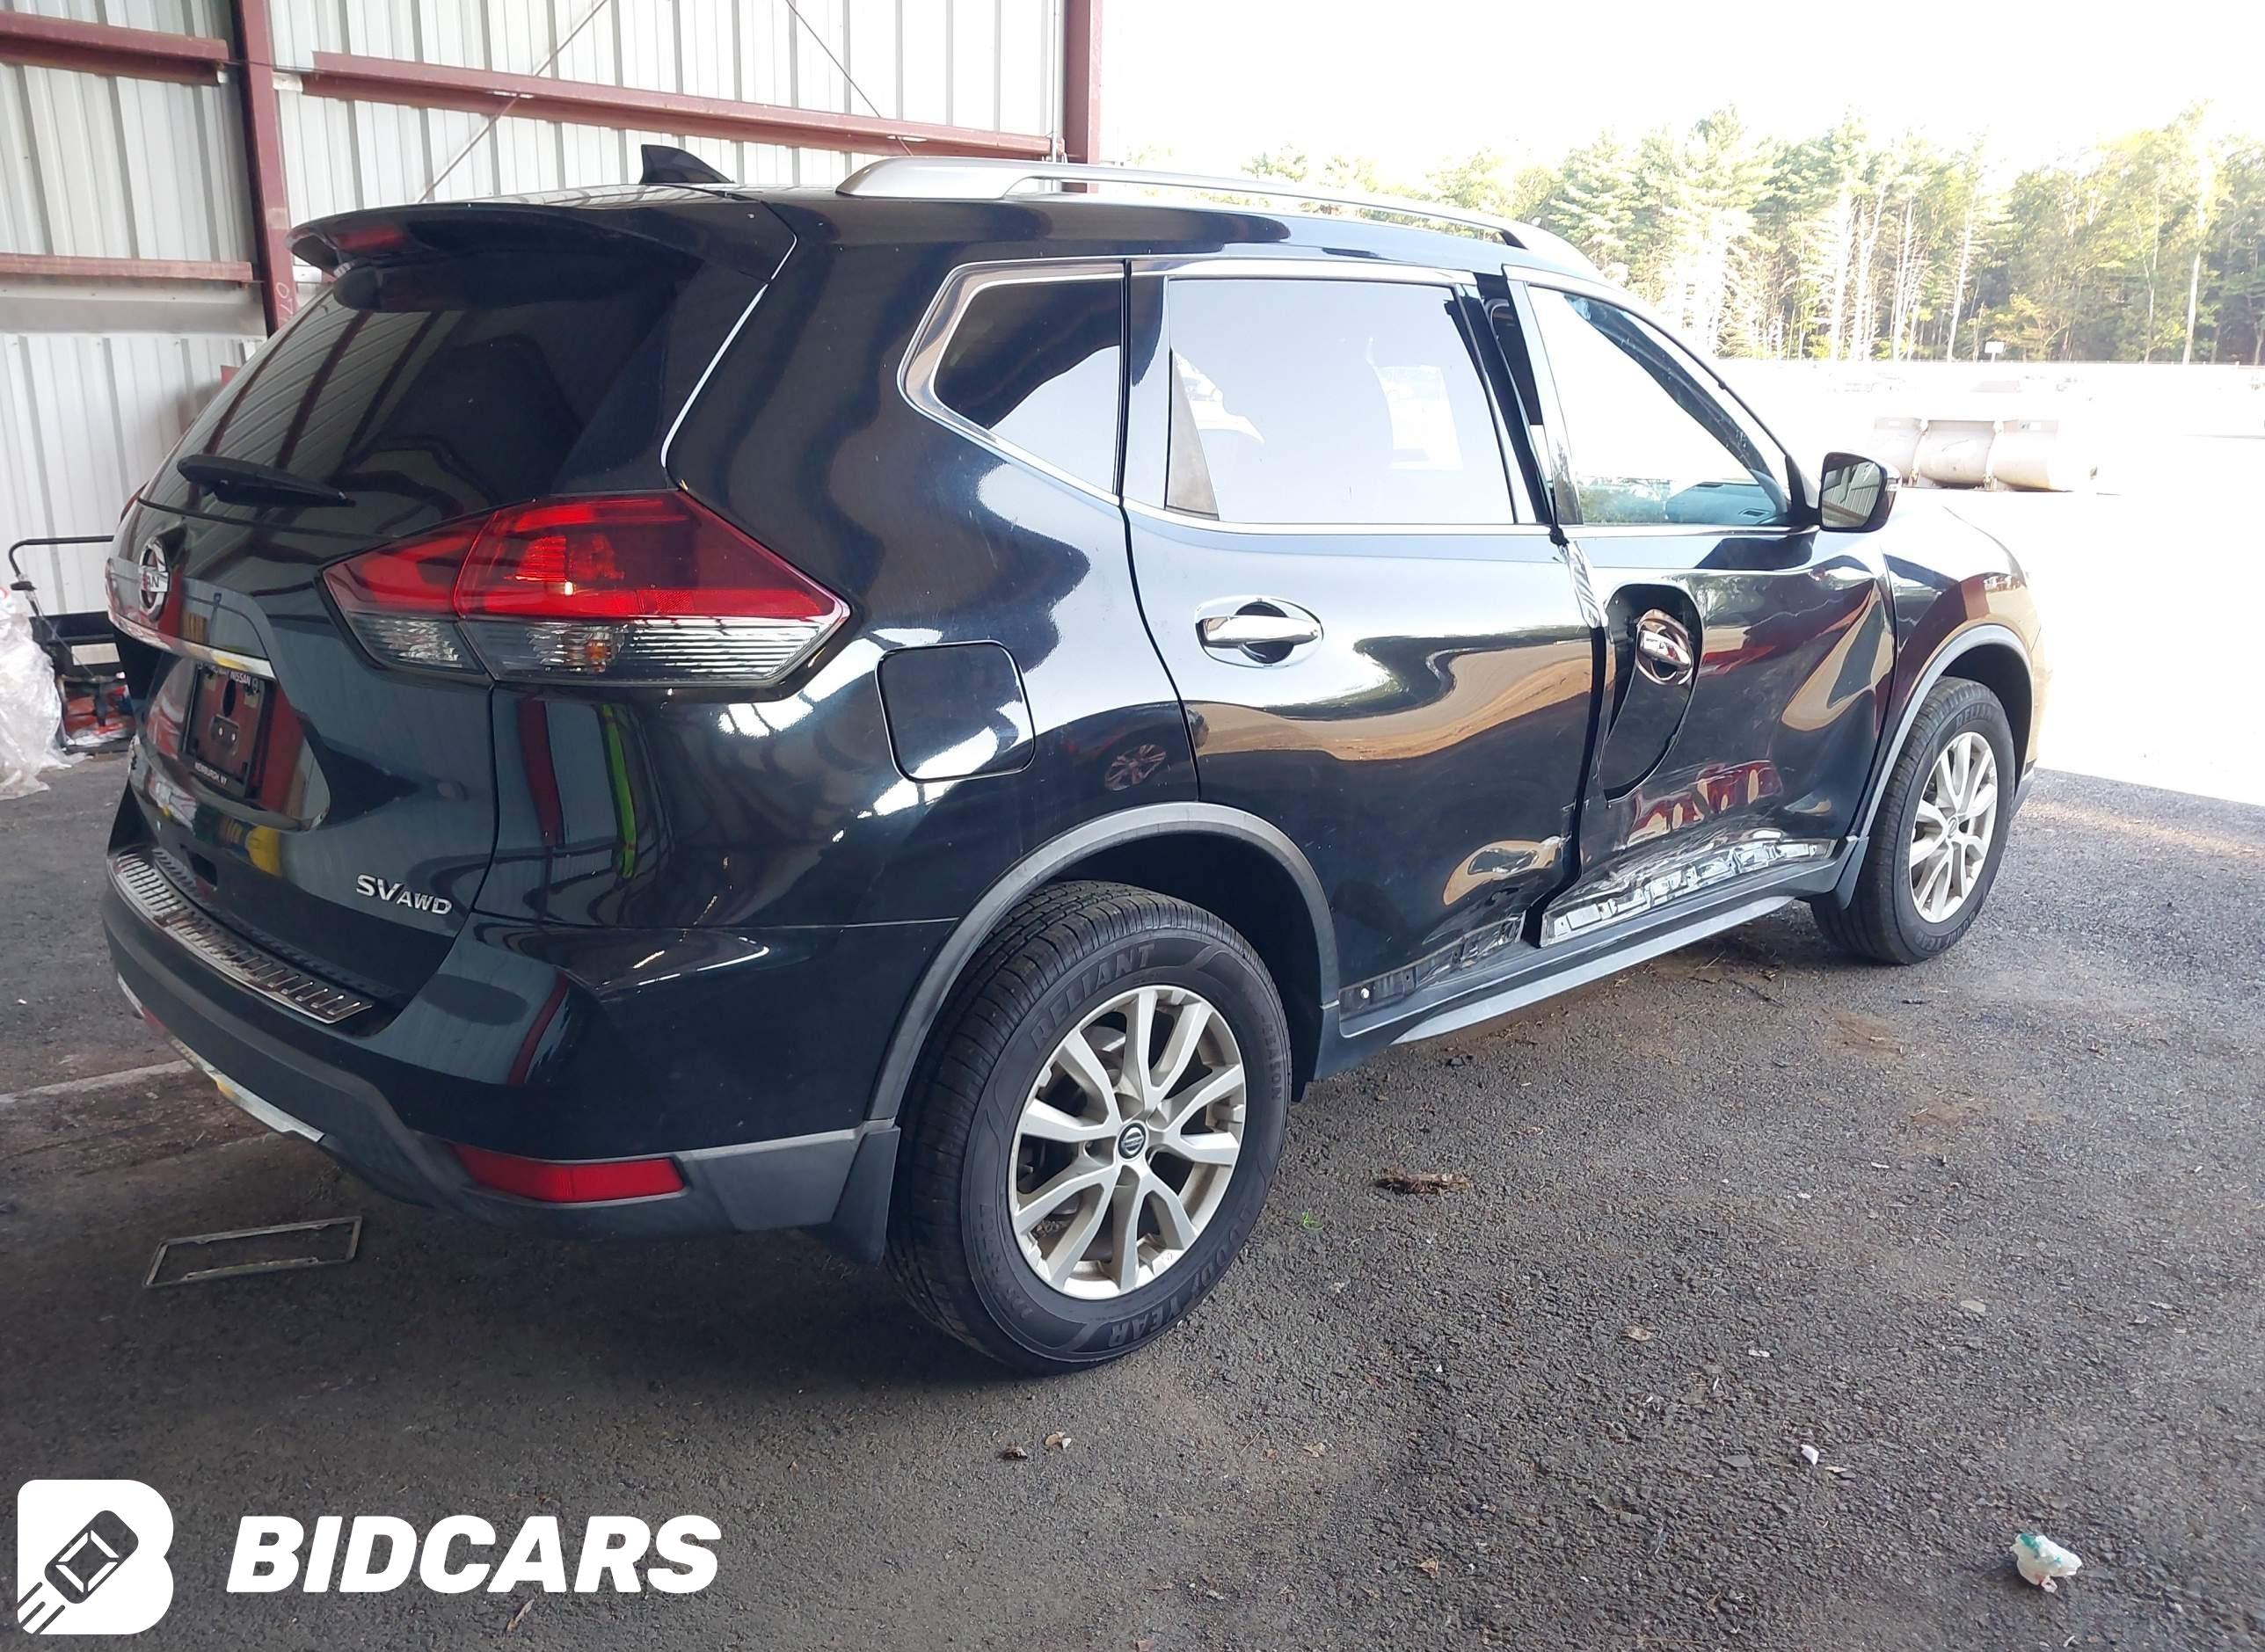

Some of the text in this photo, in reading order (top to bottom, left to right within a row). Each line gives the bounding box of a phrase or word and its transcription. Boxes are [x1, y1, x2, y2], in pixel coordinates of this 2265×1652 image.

[356, 874, 453, 914] SV AWD
[1030, 943, 1155, 1051] RELIANT
